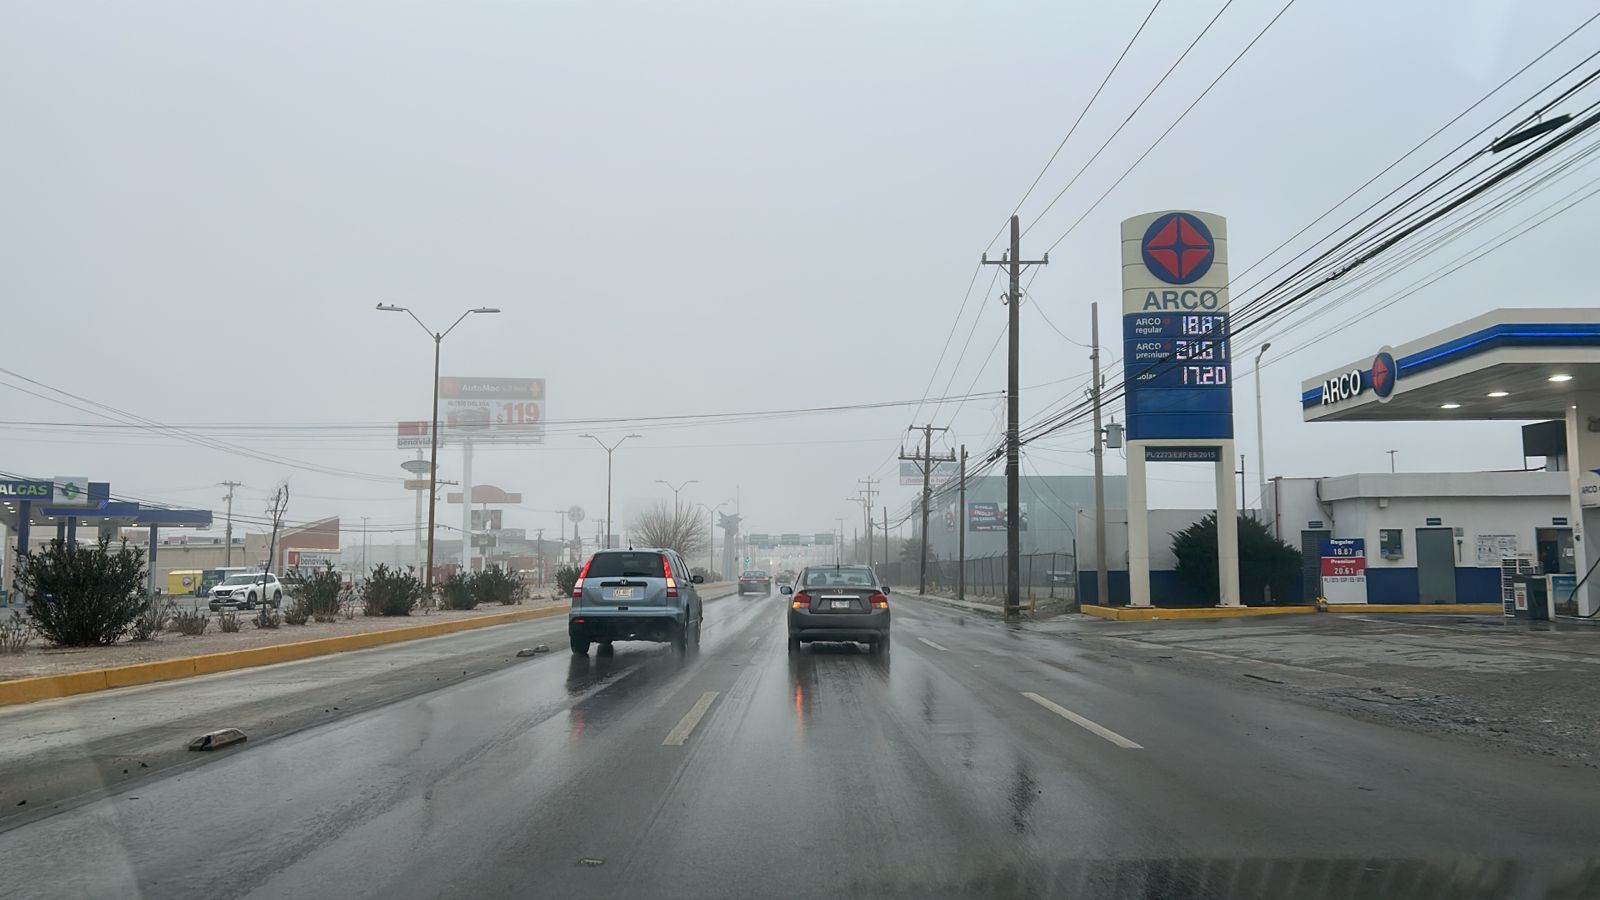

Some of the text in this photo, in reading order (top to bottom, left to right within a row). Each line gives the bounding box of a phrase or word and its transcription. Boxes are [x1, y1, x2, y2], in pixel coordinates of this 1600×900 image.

[1143, 290, 1218, 311] ARCO
[1136, 317, 1161, 325] ARCO
[1182, 316, 1225, 335] 18.87
[1135, 326, 1162, 334] regular
[1136, 342, 1161, 350] ARCO
[1176, 341, 1225, 359] 20.61
[1136, 351, 1169, 359] premium
[1183, 366, 1226, 384] 17.20
[462, 383, 500, 392] AutoMac
[1321, 369, 1361, 405] ARCO
[398, 437, 441, 446] benavid
[300, 554, 327, 566] benavid
[1334, 567, 1354, 575] 20.61
